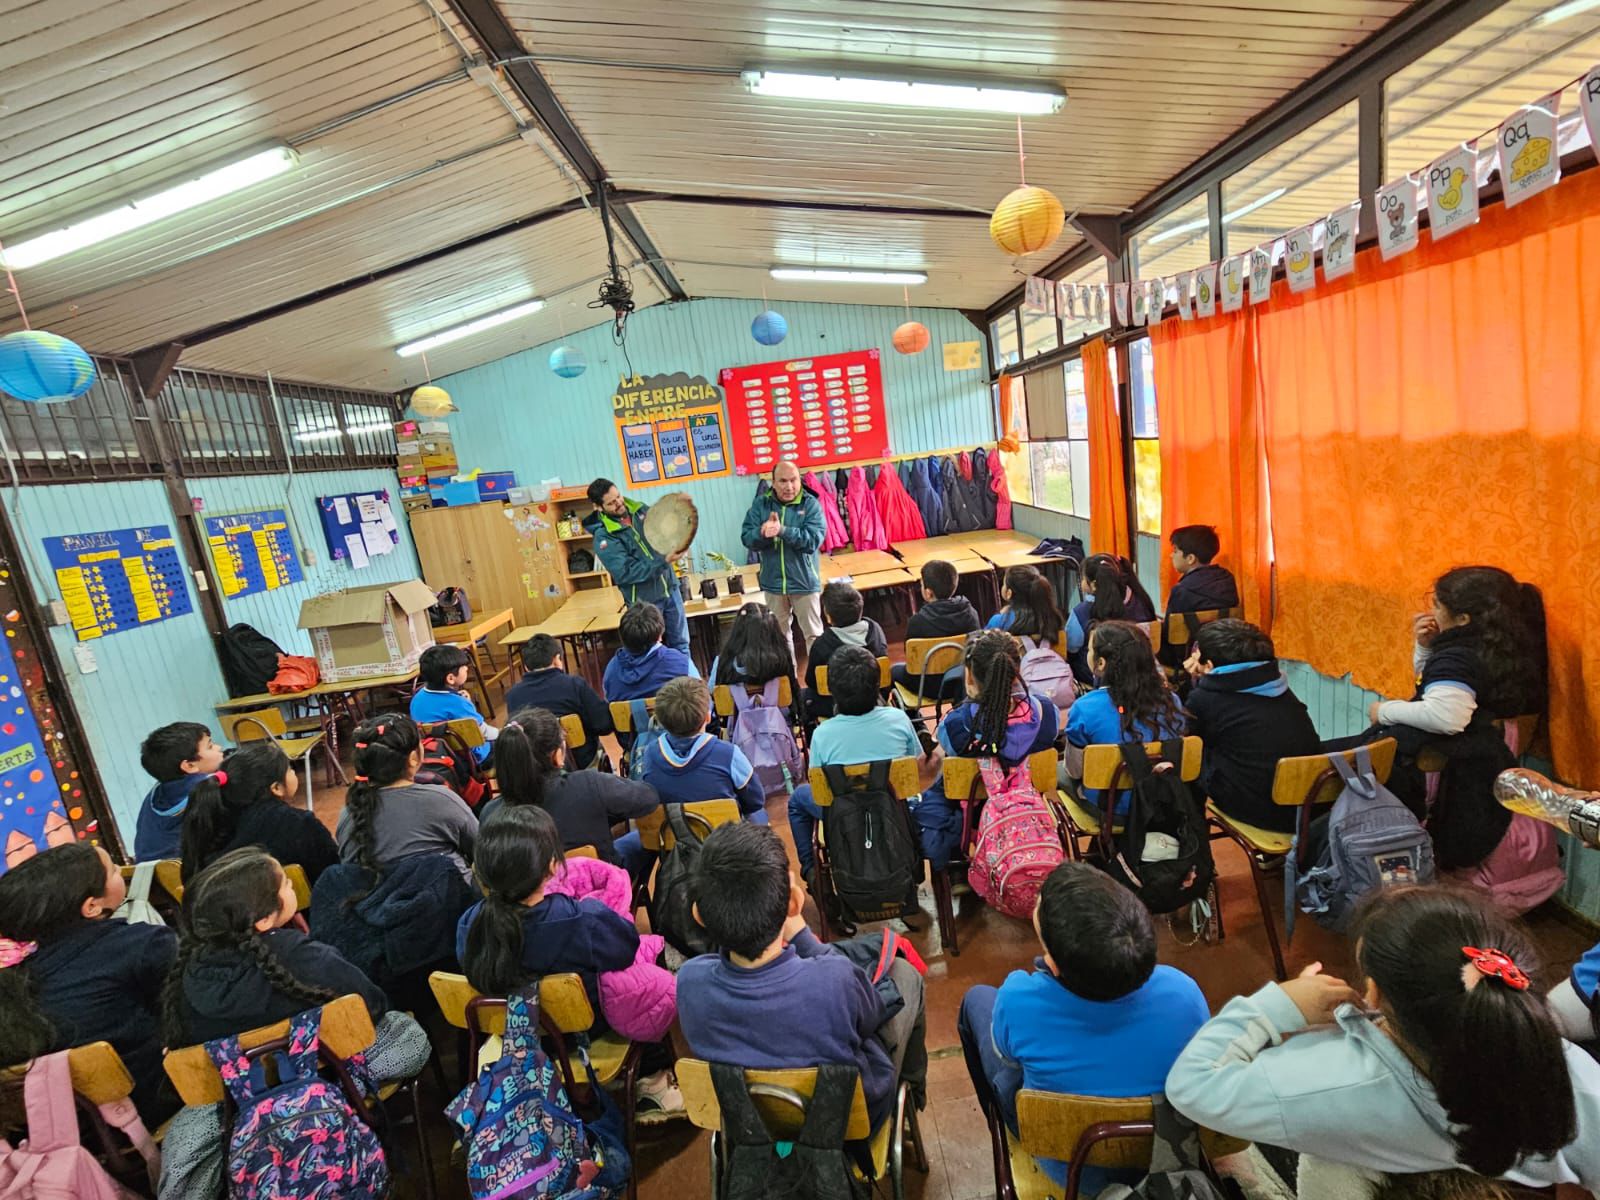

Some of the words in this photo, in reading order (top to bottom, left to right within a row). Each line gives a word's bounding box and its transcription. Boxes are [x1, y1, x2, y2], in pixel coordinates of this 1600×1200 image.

[1504, 122, 1531, 148] Qq
[1430, 167, 1451, 188] Pp
[1381, 195, 1397, 212] Oo
[620, 372, 644, 388] LA
[612, 383, 717, 409] DIFERENCIA
[625, 403, 687, 425] ENTRE
[628, 450, 654, 459] HABER
[662, 445, 688, 456] LUGAR
[62, 533, 121, 552] PANEL
[135, 528, 154, 543] DE
